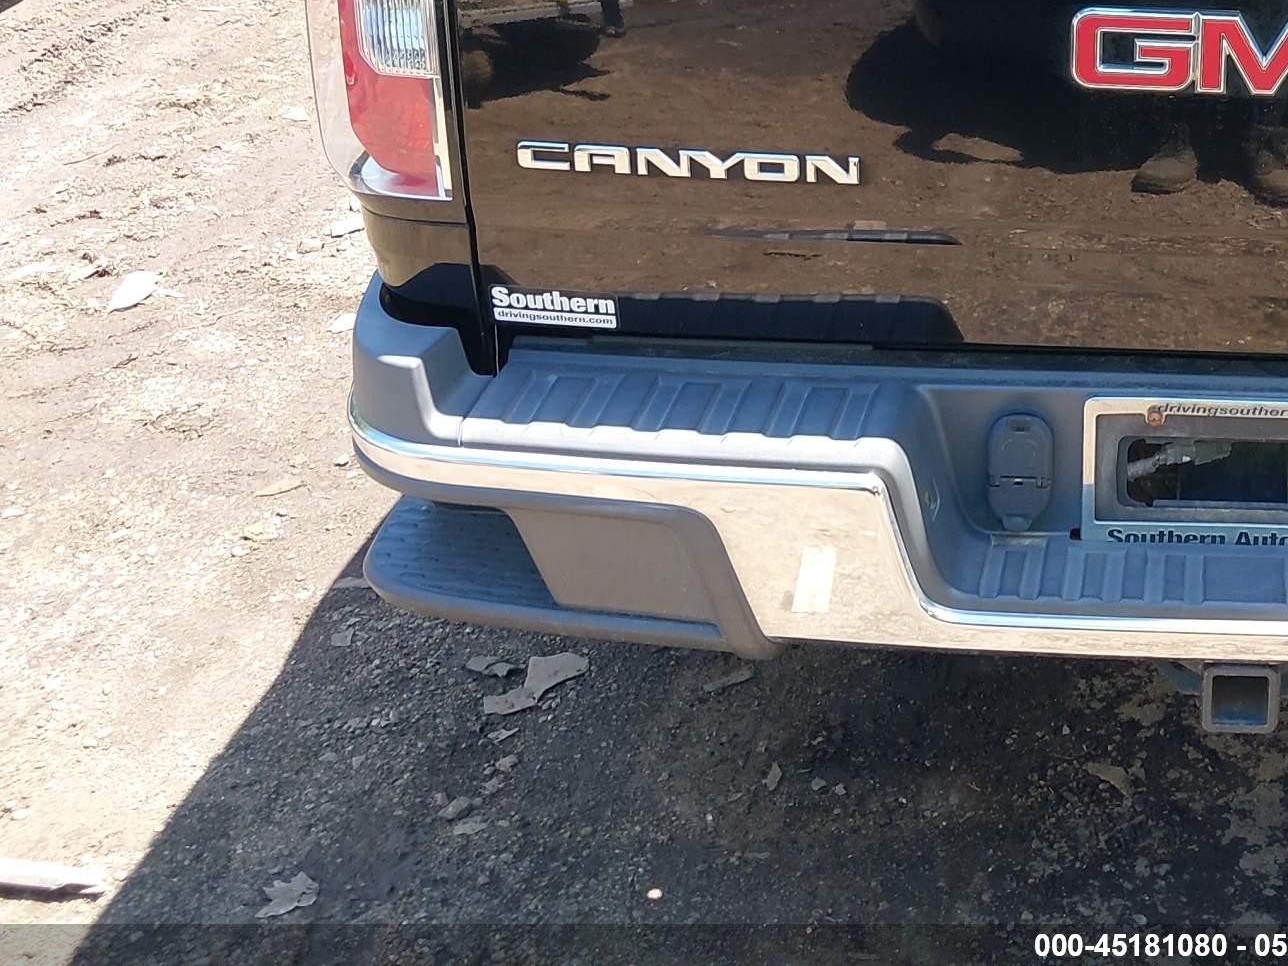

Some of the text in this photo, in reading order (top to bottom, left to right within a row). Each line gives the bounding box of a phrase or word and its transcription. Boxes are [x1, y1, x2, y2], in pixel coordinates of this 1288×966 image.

[516, 139, 861, 185] CANYON
[491, 286, 616, 315] Southern
[497, 309, 614, 325] drivingsouthern.com
[1107, 529, 1227, 545] Southern
